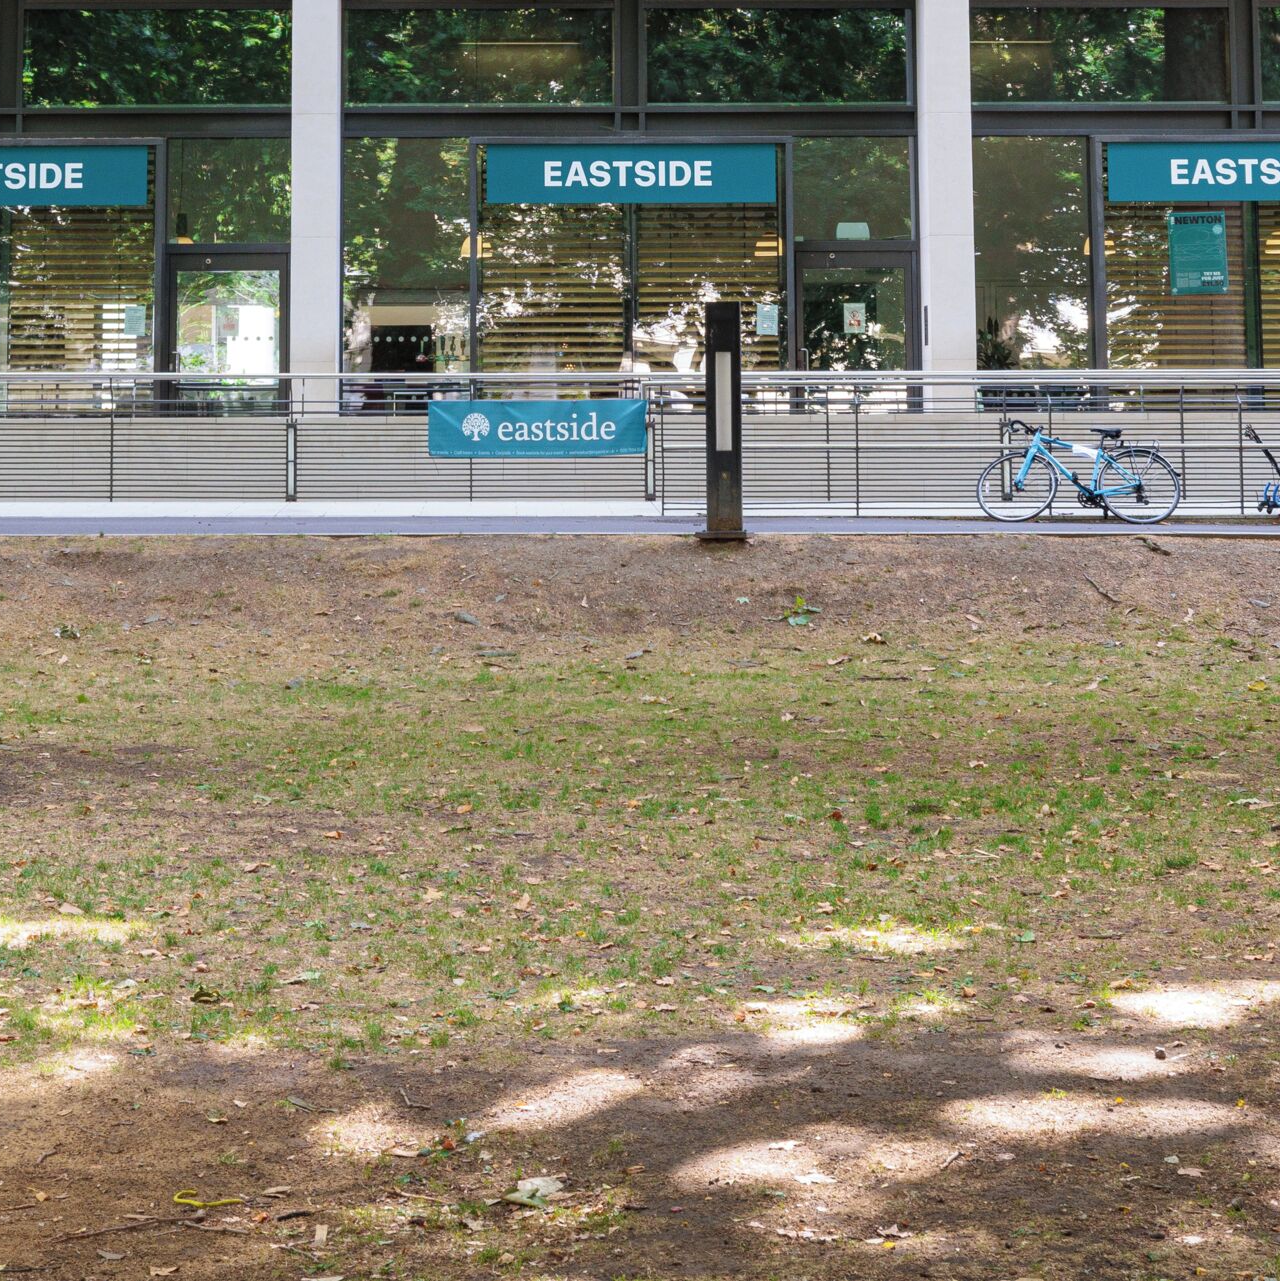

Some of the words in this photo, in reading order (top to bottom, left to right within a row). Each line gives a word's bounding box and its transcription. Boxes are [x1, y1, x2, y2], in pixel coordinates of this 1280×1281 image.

[544, 160, 713, 187] EASTSIDE
[1175, 216, 1222, 224] NEWTON
[497, 412, 616, 441] eastside
